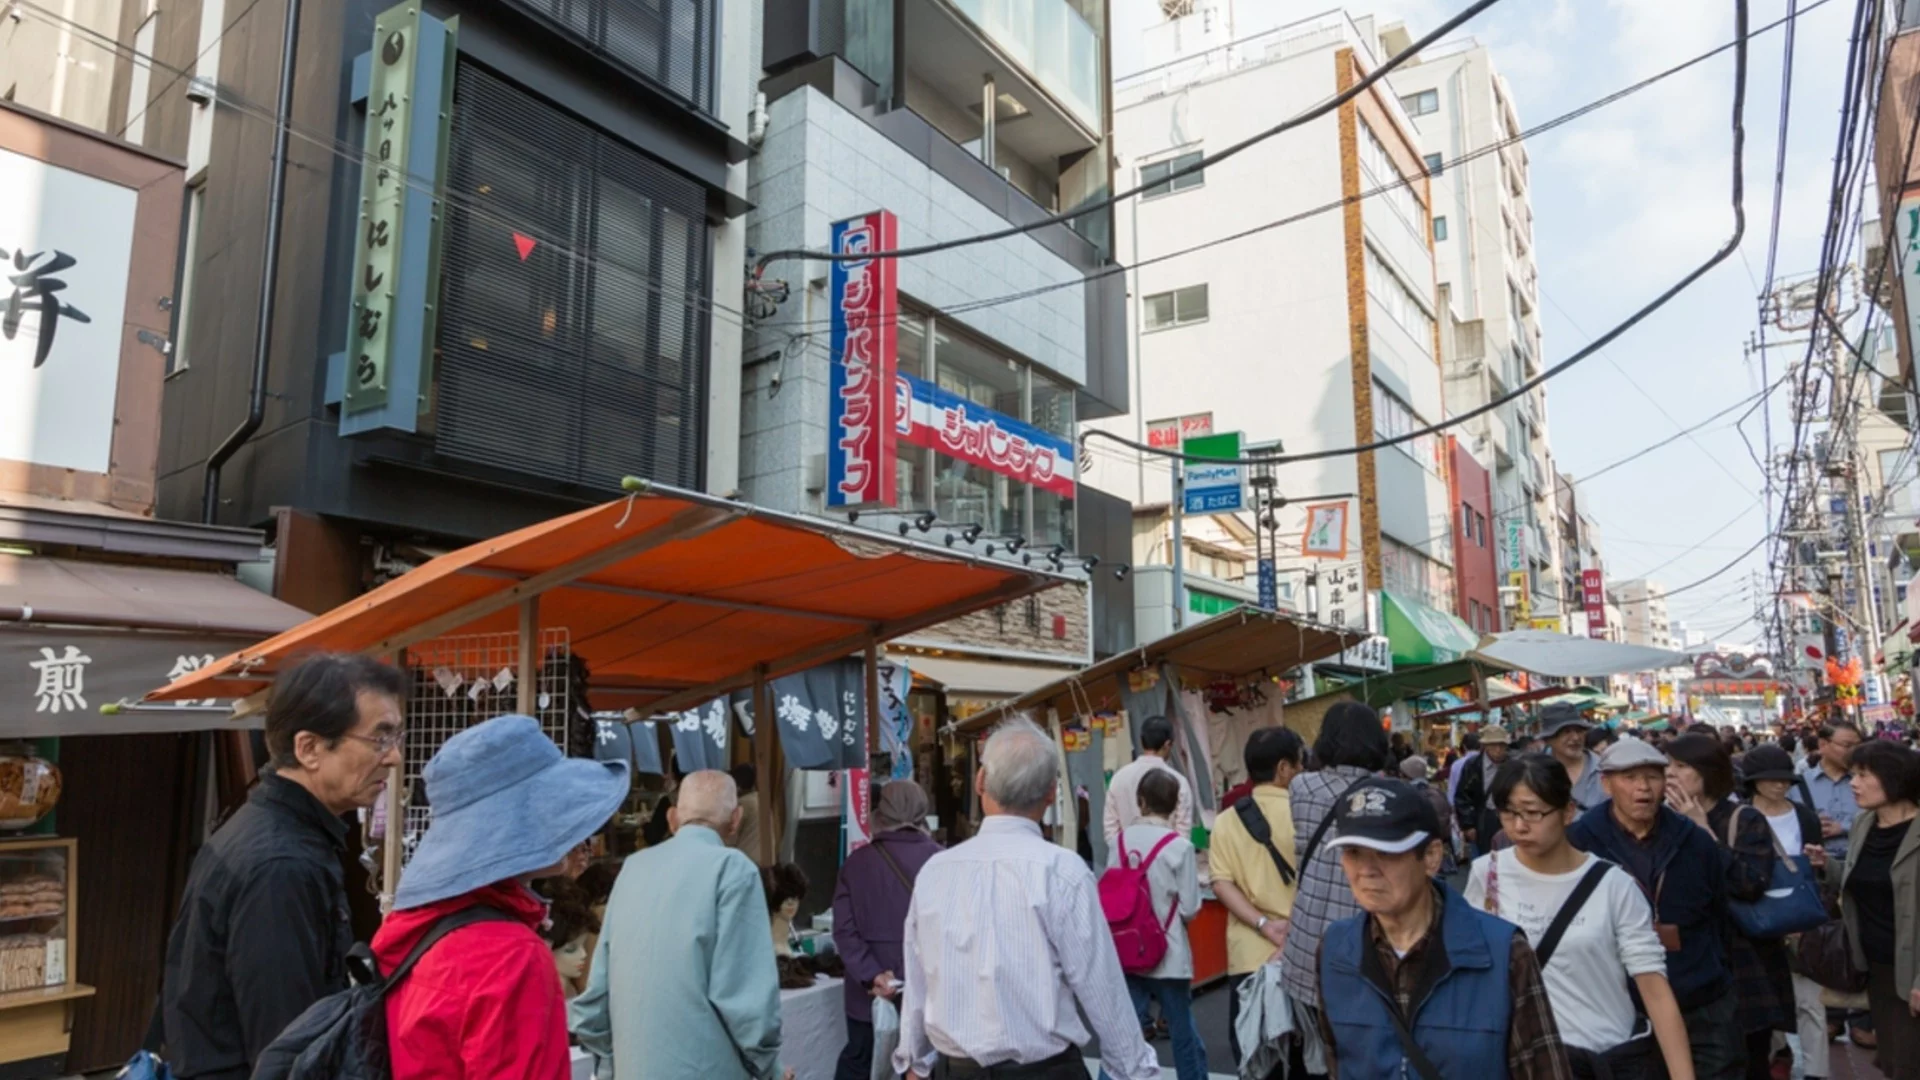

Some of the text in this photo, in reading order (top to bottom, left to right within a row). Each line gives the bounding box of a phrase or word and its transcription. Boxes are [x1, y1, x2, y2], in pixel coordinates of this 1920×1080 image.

[356, 219, 389, 385] にしむら
[839, 272, 873, 495] ジャパンライフ
[941, 404, 1056, 481] ジャパンライフ
[1186, 467, 1237, 481] FamilyMart
[1207, 493, 1238, 507] たばこ
[842, 690, 858, 746] にしむら
